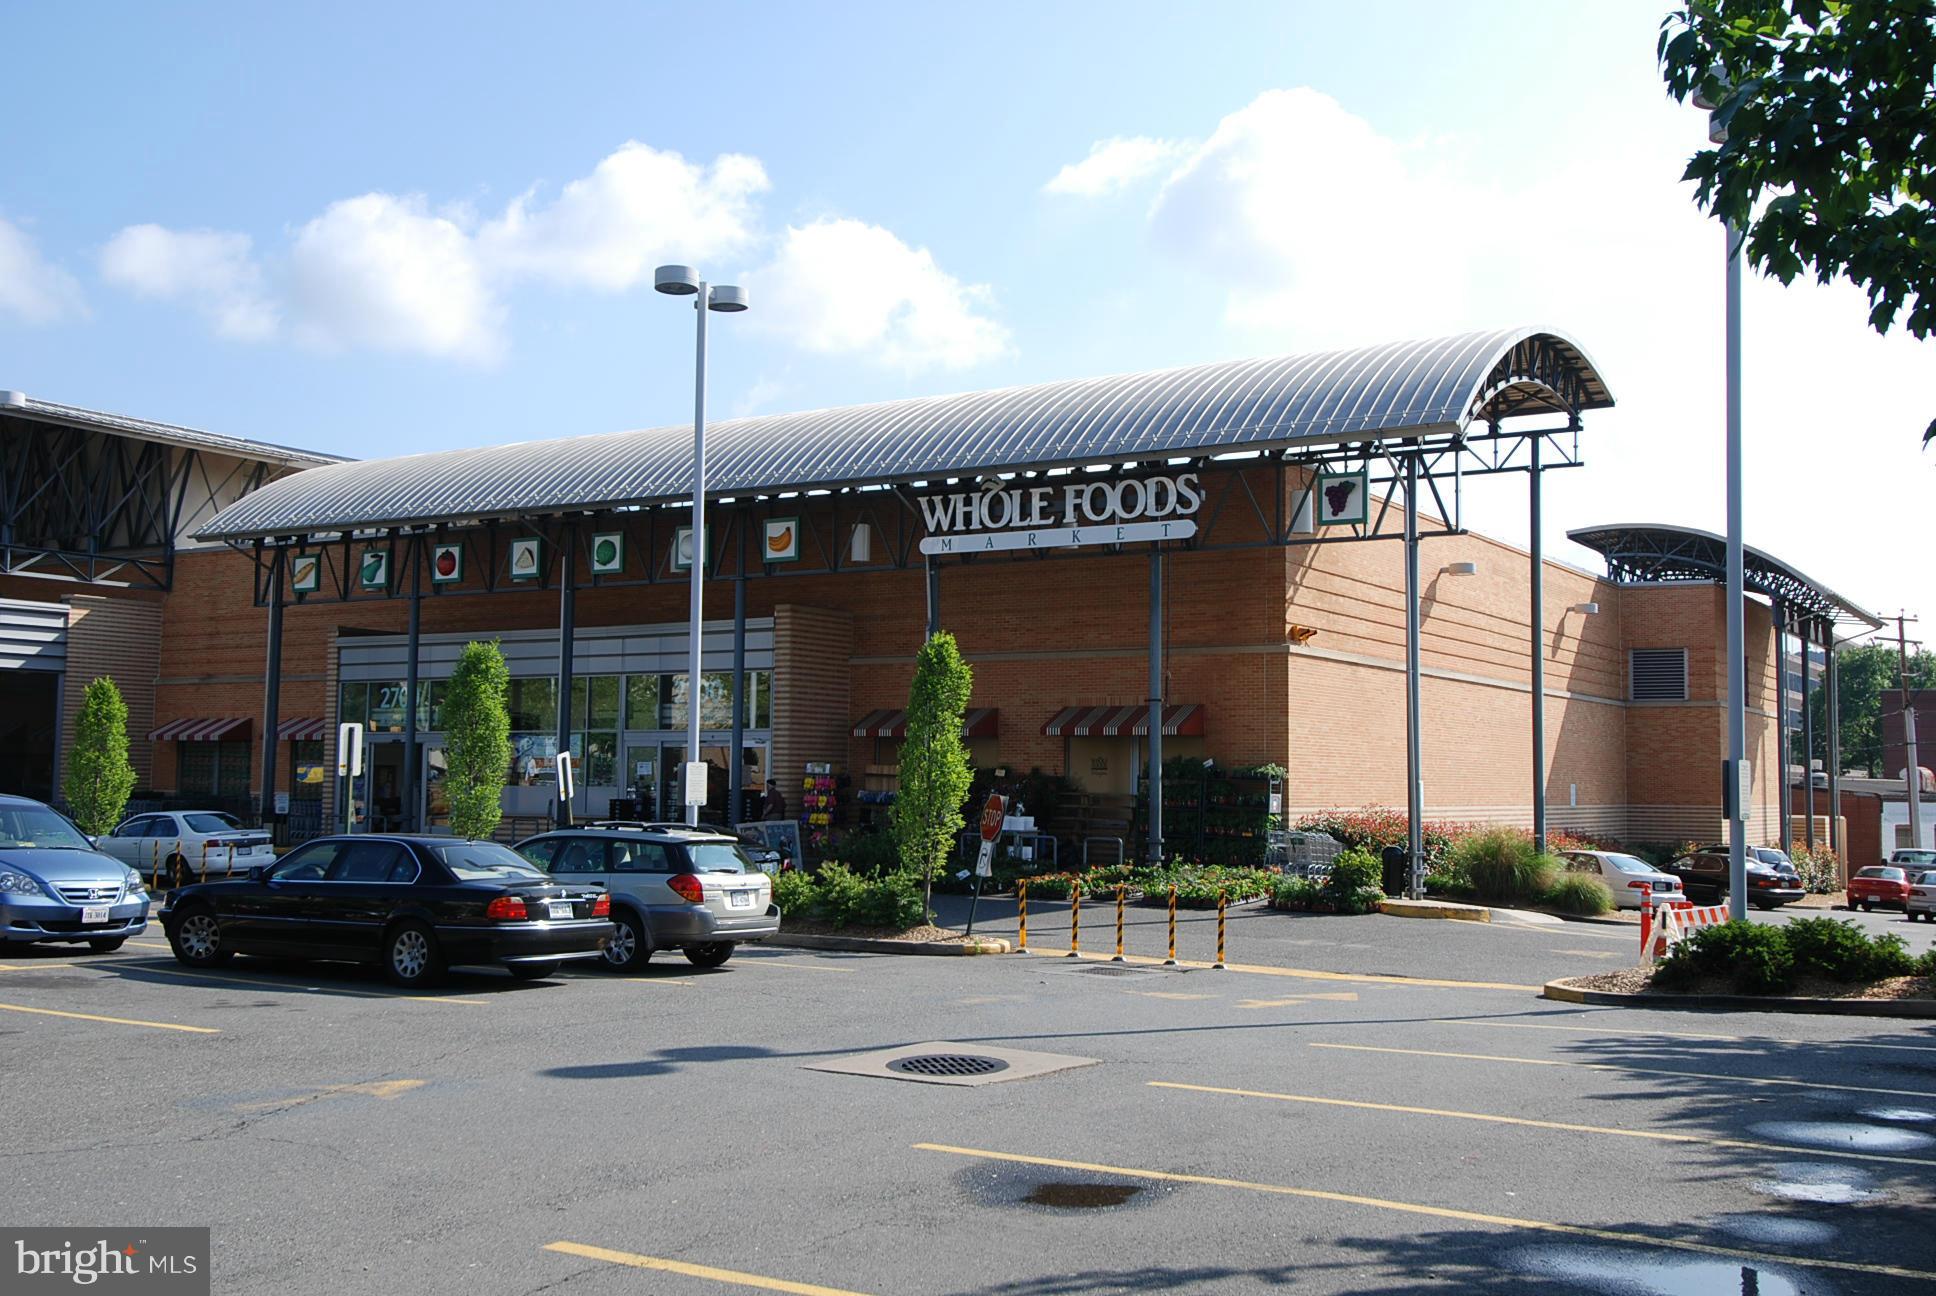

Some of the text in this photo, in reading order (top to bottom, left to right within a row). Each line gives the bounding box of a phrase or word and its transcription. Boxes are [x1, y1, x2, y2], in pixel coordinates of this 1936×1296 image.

[917, 473, 1201, 533] WHOLE FOODS
[941, 523, 1172, 553] MARKET
[982, 809, 1001, 826] STOP
